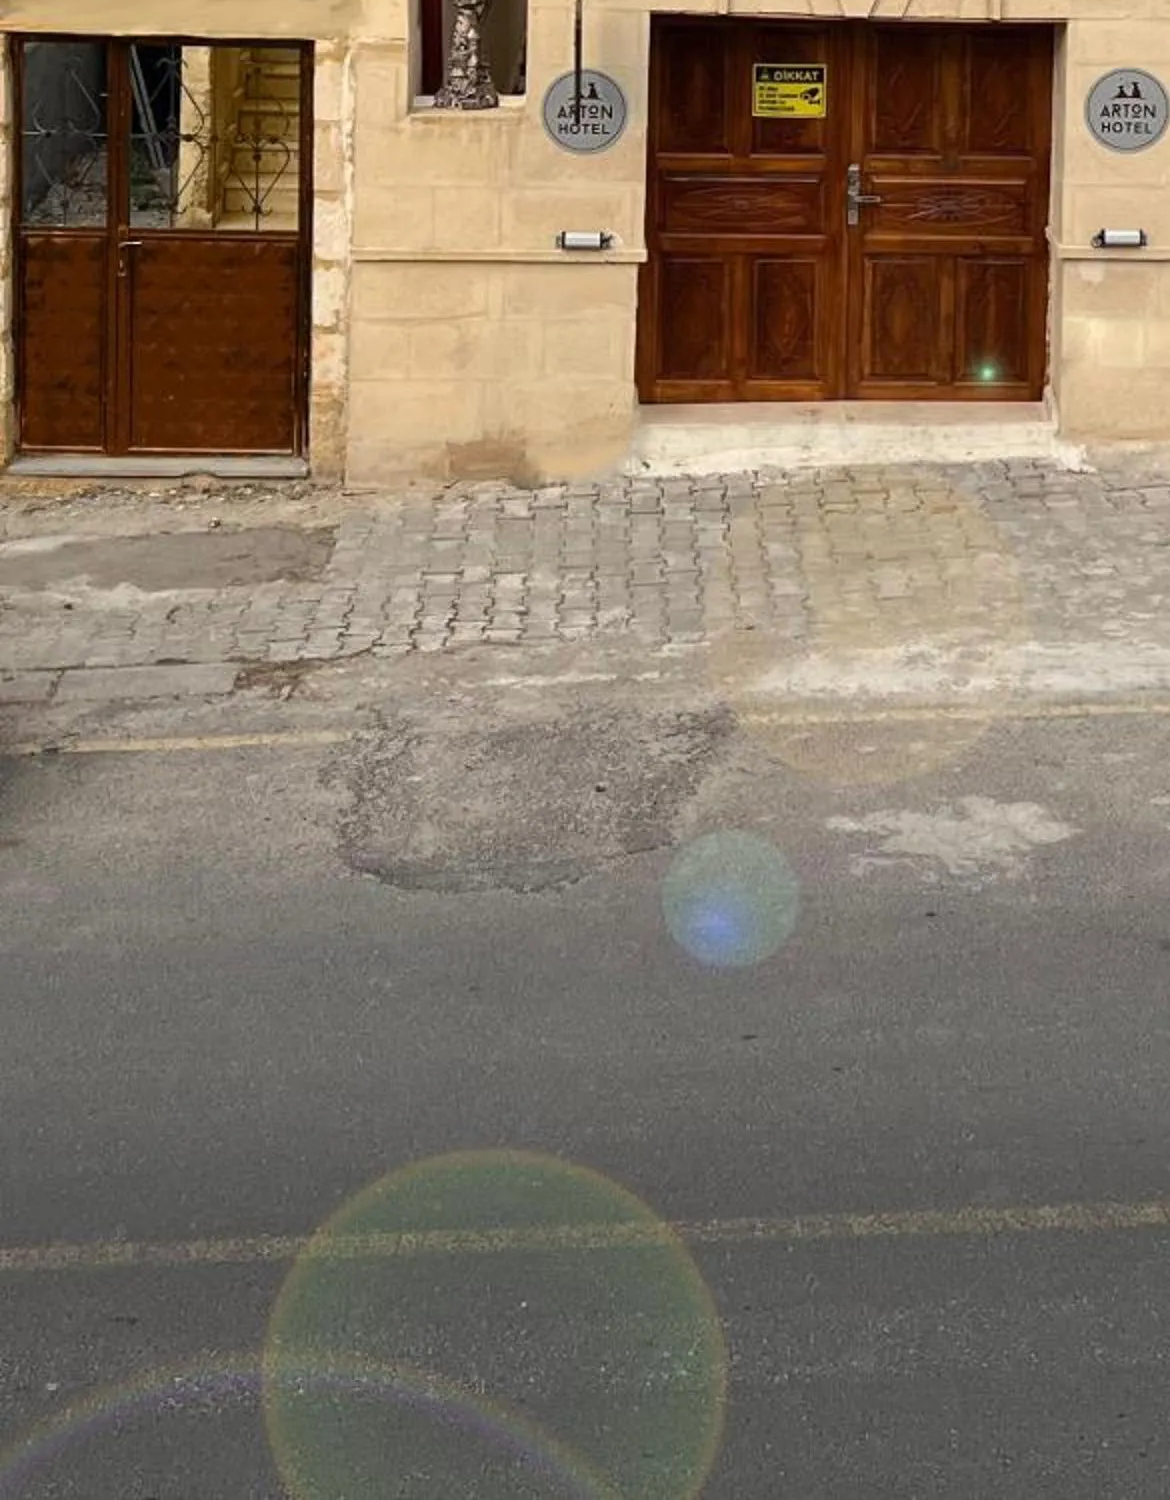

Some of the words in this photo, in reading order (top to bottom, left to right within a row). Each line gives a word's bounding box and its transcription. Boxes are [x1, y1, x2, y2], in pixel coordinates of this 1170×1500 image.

[1100, 103, 1157, 118] ARTON
[558, 123, 610, 135] HOTEL
[1101, 121, 1153, 134] HOTEL
